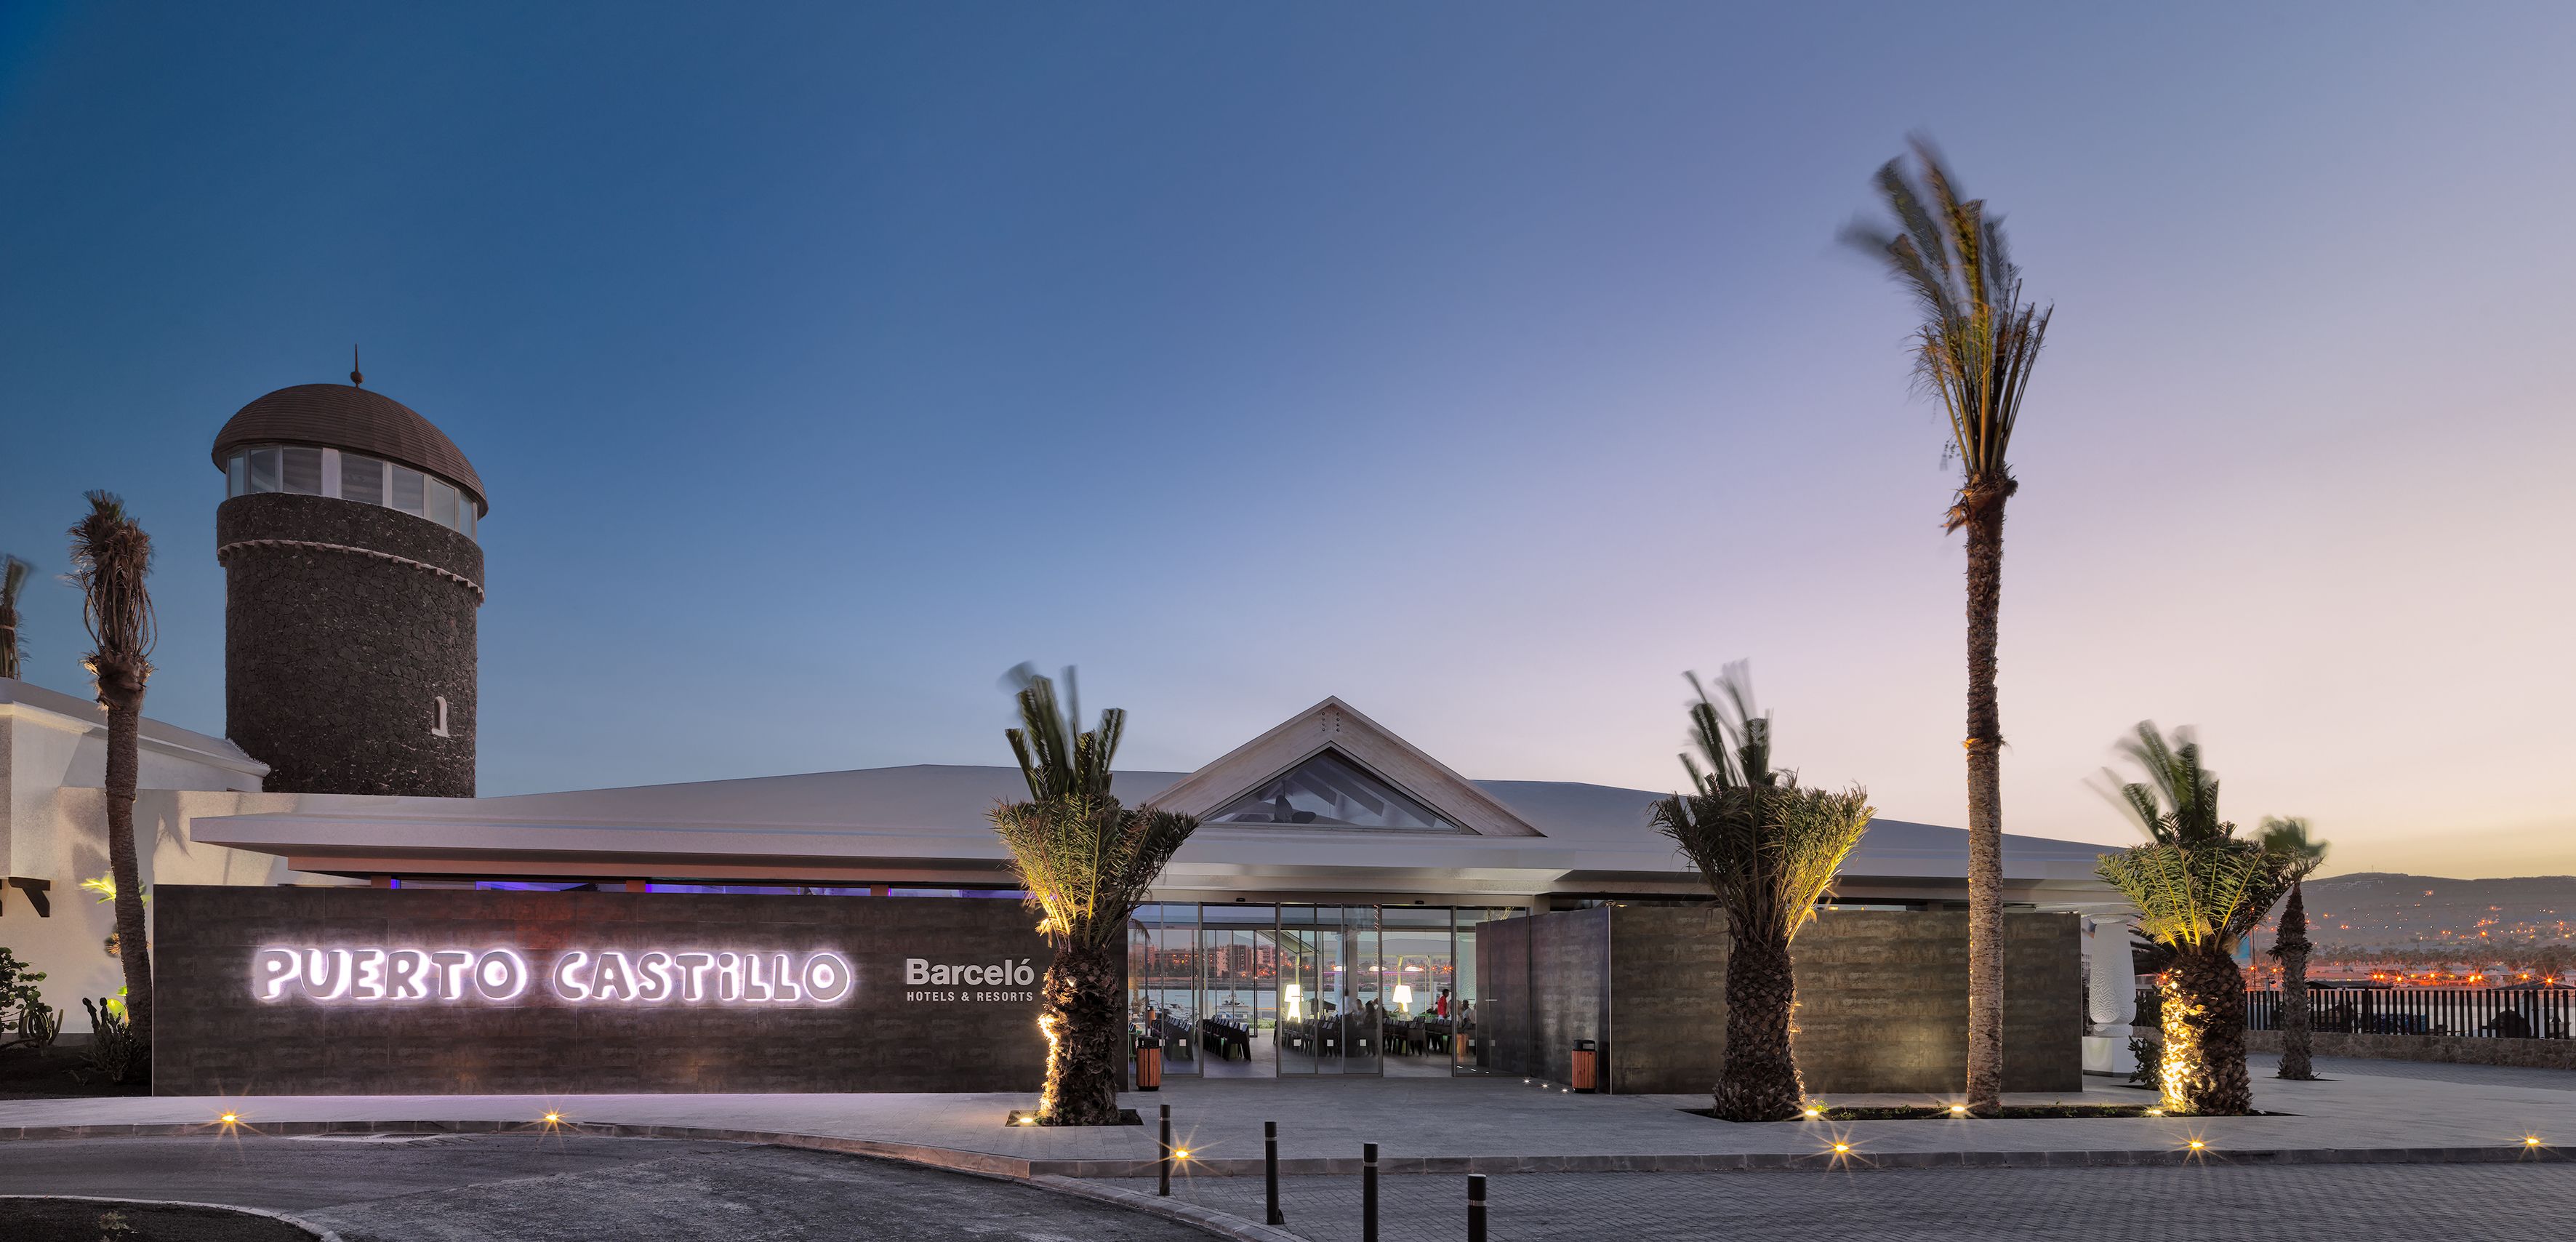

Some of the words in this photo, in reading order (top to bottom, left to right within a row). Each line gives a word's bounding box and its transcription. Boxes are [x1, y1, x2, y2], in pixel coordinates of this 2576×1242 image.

[254, 948, 526, 1000] PUERTO
[906, 958, 1035, 986] Barceló
[907, 991, 955, 1002] HOTELS
[960, 991, 970, 1002] &
[976, 991, 1034, 1002] RESORTS
